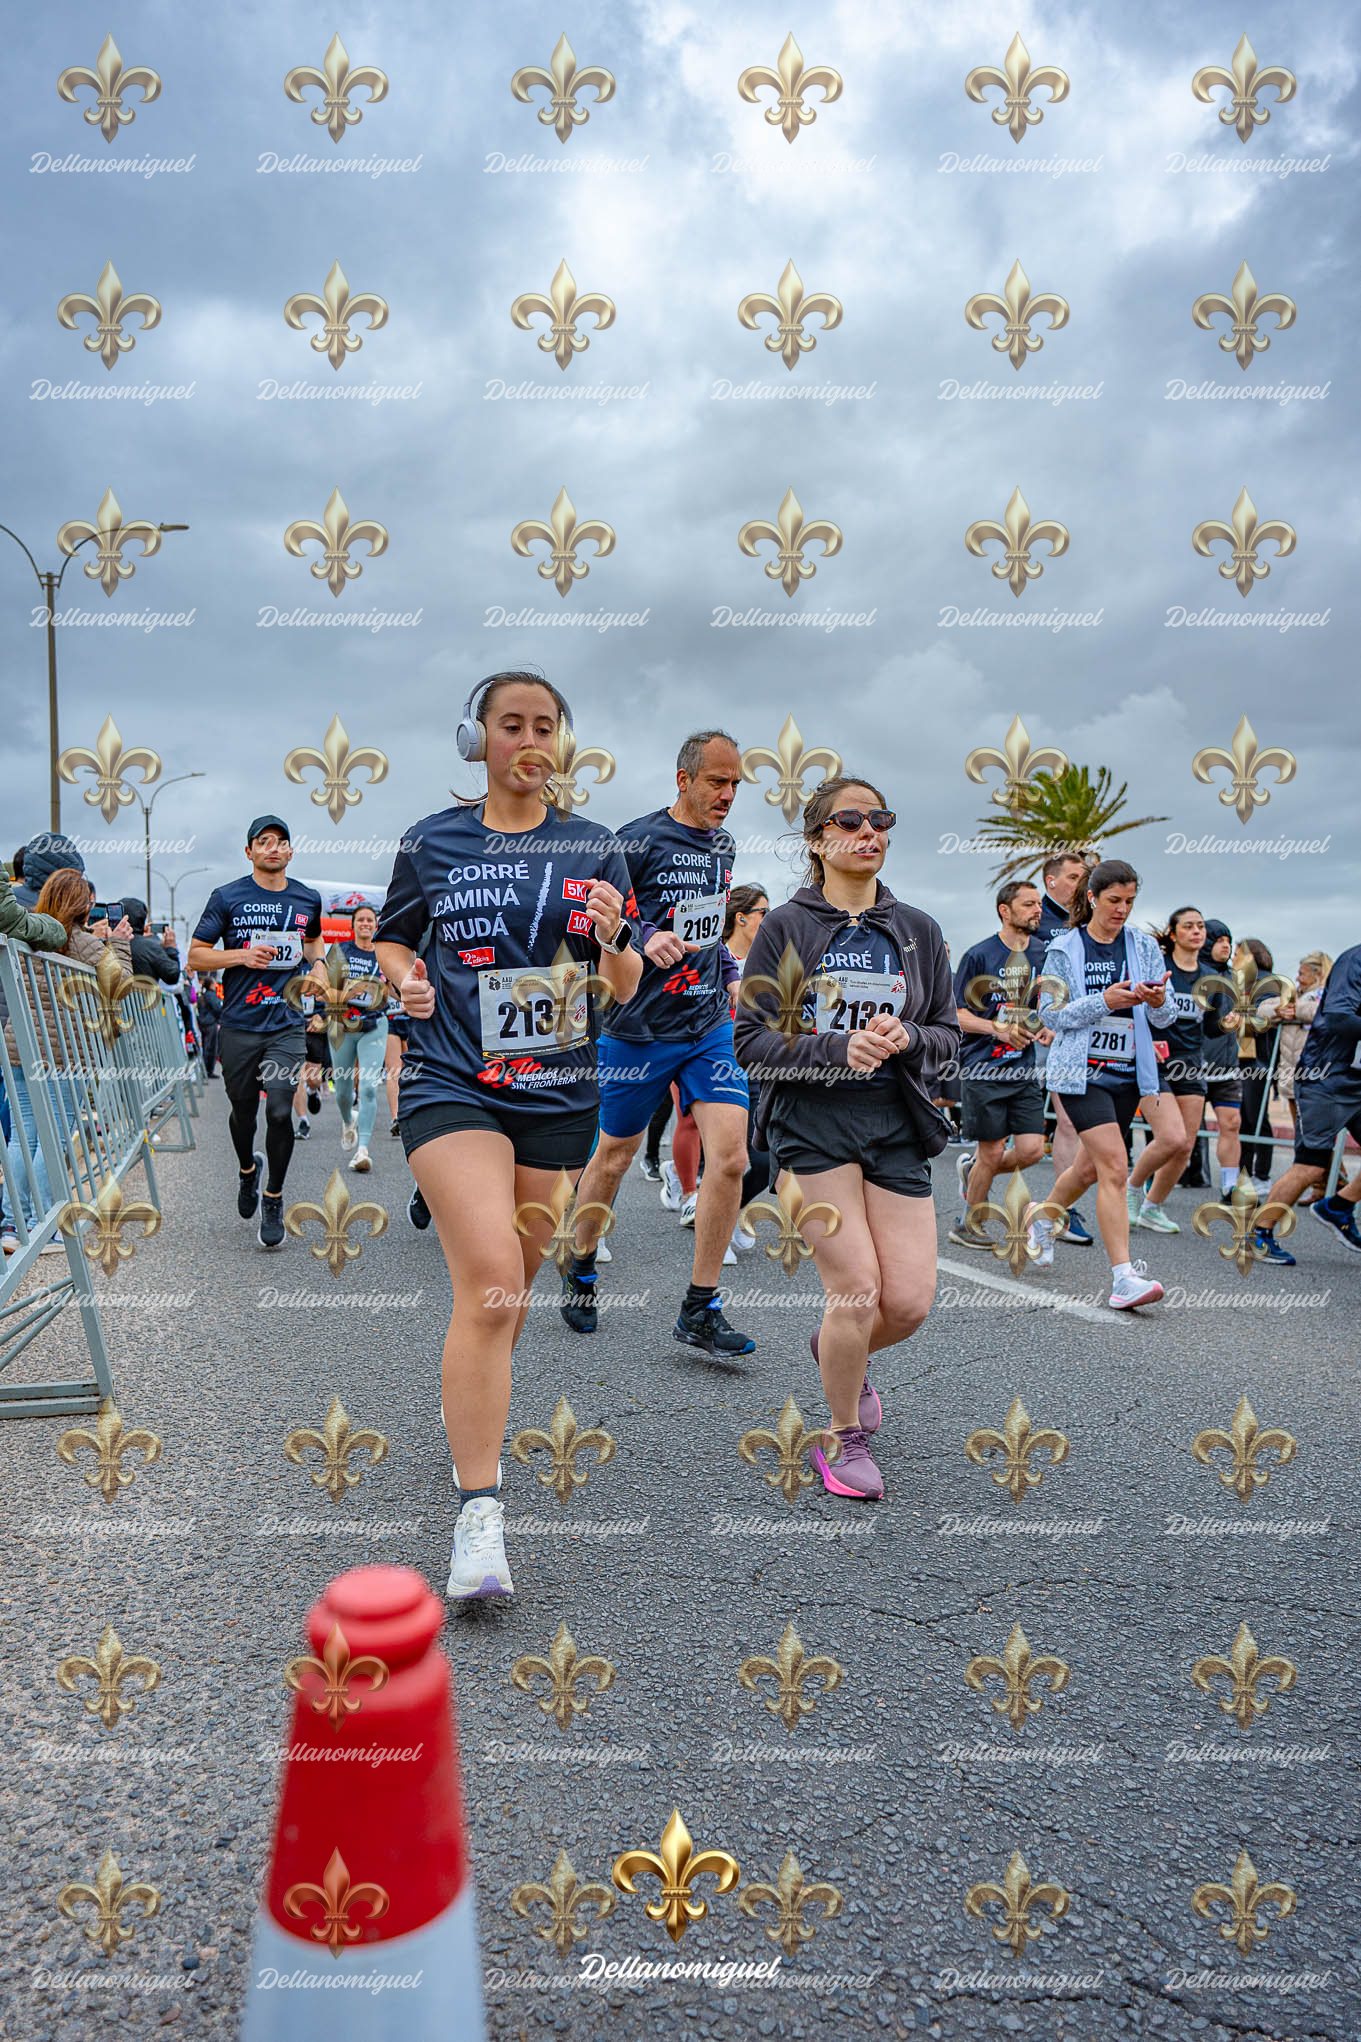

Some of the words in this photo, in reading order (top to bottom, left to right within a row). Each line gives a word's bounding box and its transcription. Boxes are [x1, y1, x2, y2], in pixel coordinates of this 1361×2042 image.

[672, 853, 711, 868] CORRÉ
[447, 860, 530, 885] CORRÉ
[656, 870, 709, 886] CAMINÁ
[567, 882, 585, 899] 5K
[243, 903, 283, 914] CORRÉ
[433, 883, 520, 918] CAMINÁ
[232, 915, 278, 926] CAMINÁ
[443, 911, 509, 942] AYUDÁ
[683, 914, 720, 942] 2192
[998, 965, 1029, 977] CORRÉ
[1174, 998, 1196, 1013] 931
[1091, 1030, 1127, 1051] 2781
